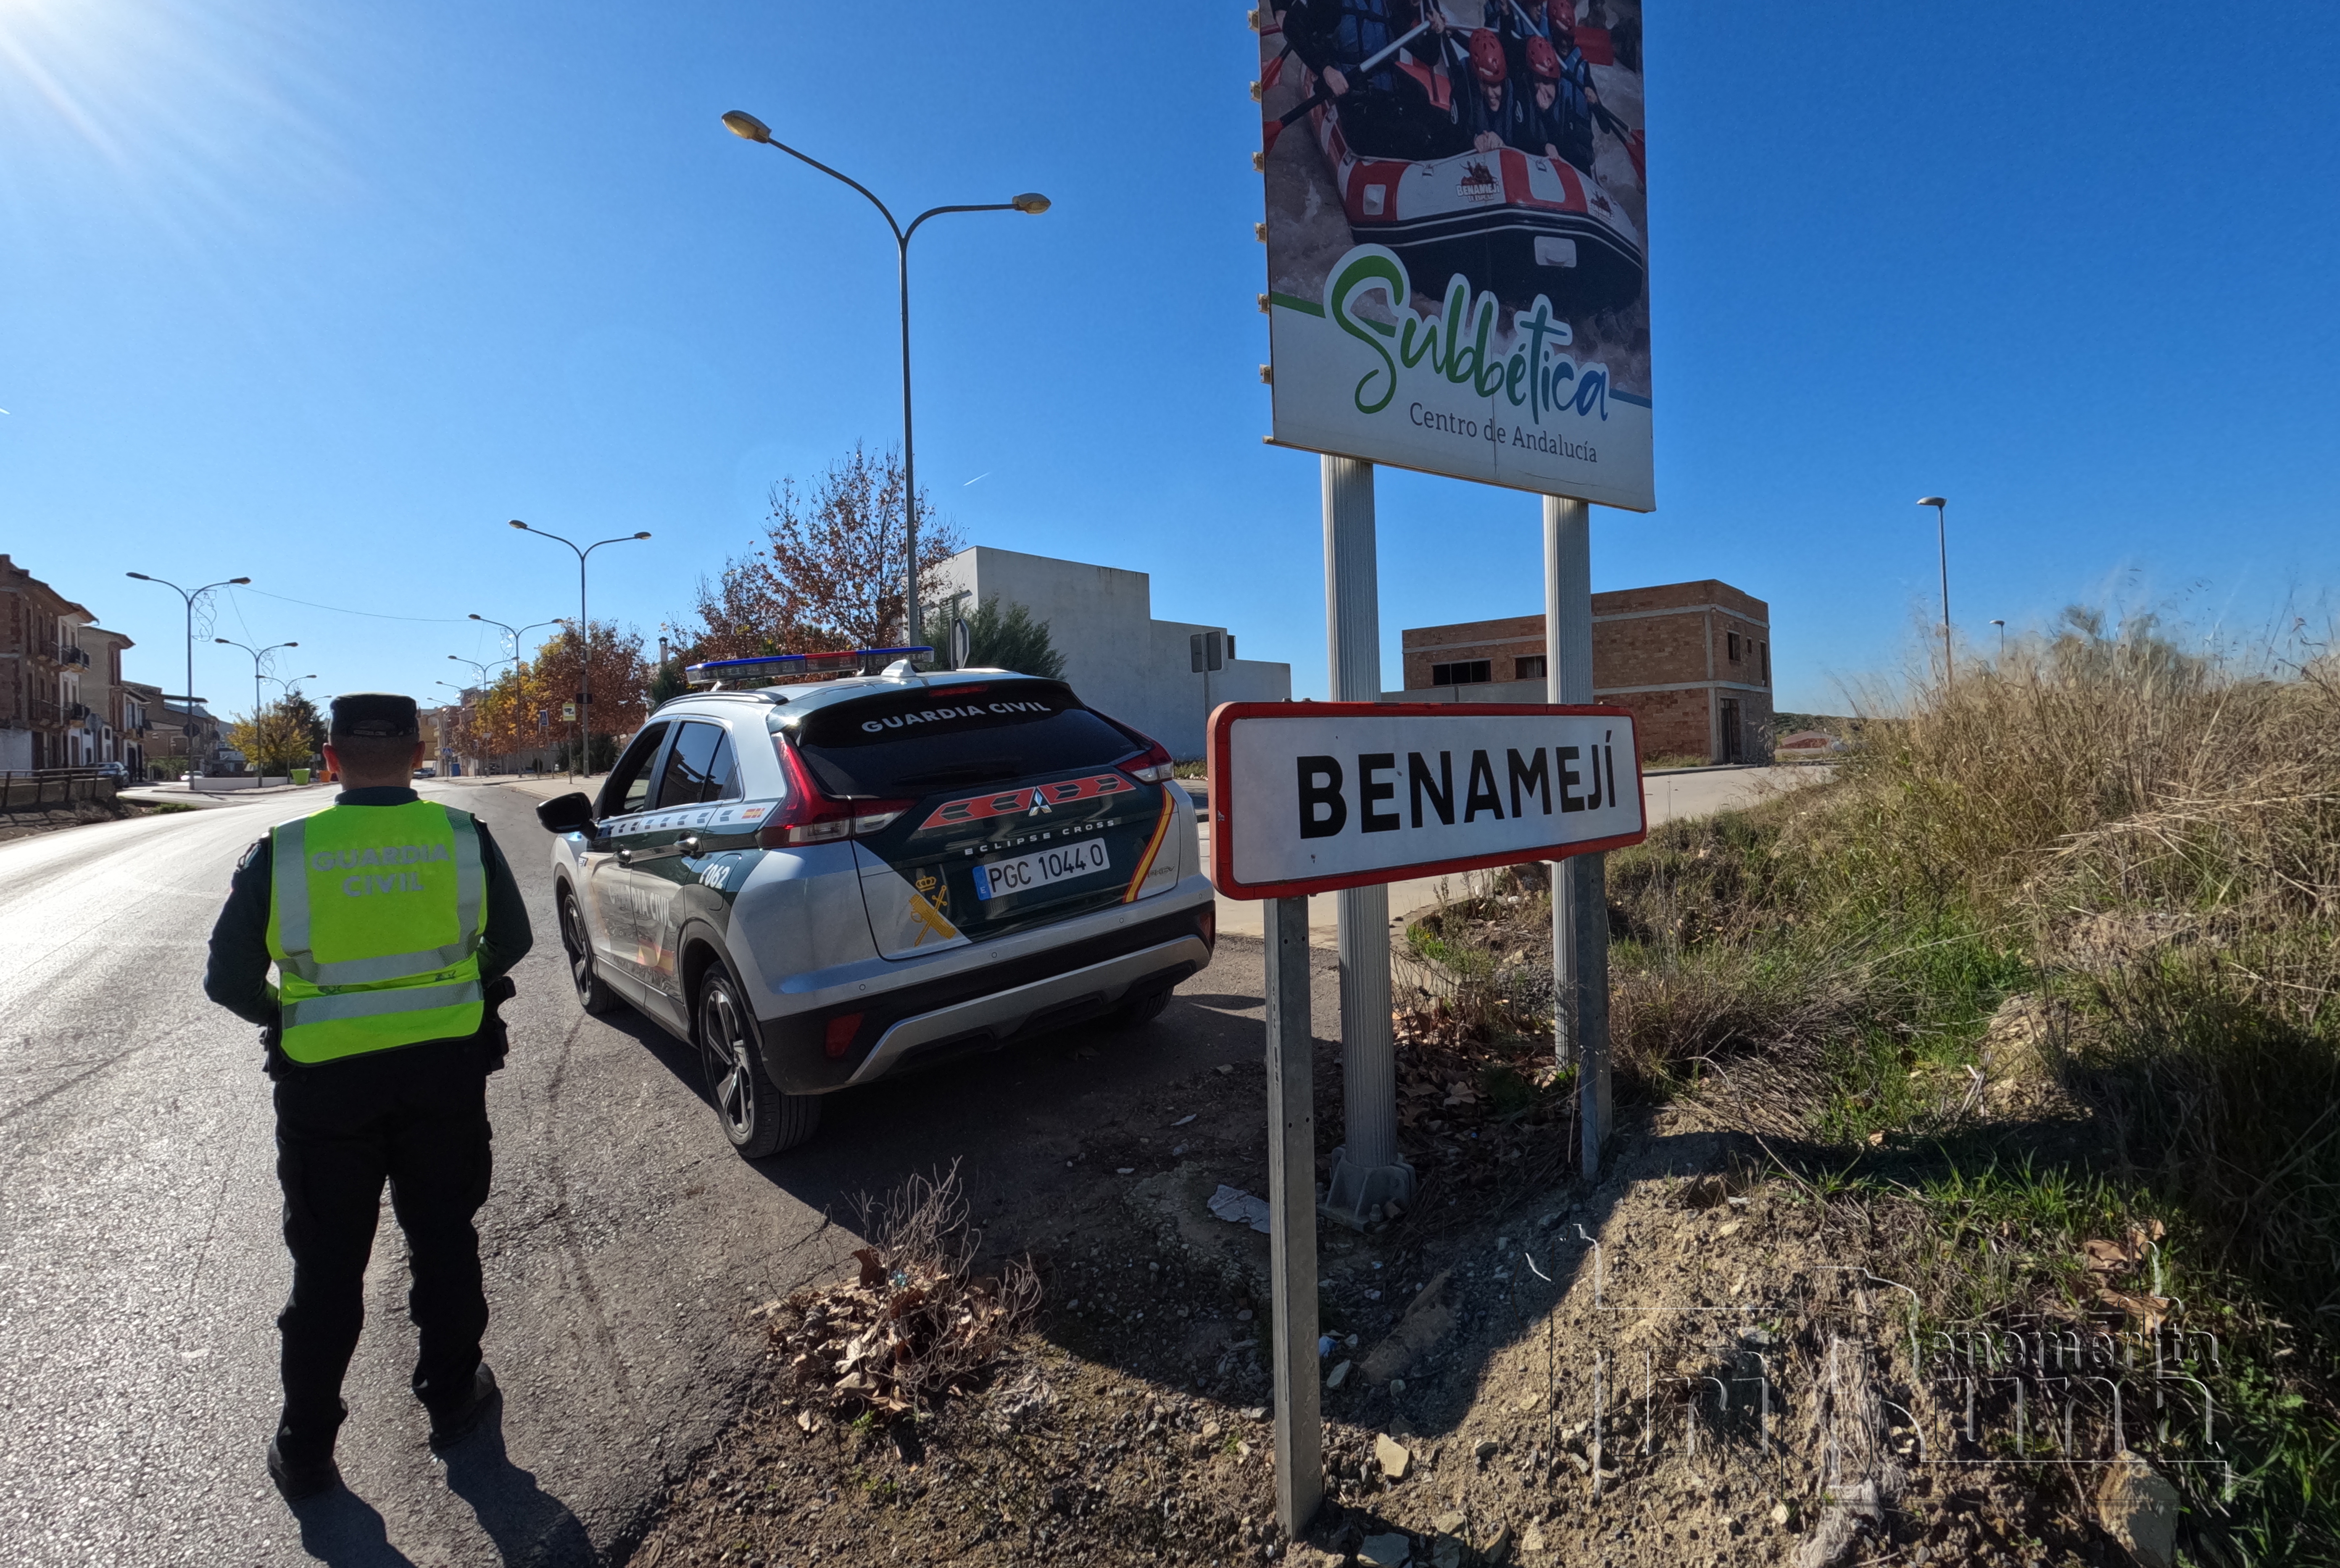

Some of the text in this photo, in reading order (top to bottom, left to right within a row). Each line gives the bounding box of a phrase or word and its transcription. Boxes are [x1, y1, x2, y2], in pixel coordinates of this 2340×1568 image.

[1331, 255, 1608, 424] Subbética
[1410, 402, 1597, 463] Centro de Andalucía
[862, 702, 1051, 732] GUARDIA CIVIL
[1296, 730, 1616, 839] BENAMEJÍ
[964, 820, 1114, 855] ECLIPSE CROSS
[312, 844, 450, 871] GUARDIA
[988, 861, 1032, 893] PGC
[1038, 848, 1086, 880] 1044
[343, 872, 424, 897] CIVIL
[650, 892, 673, 928] CIVIL
